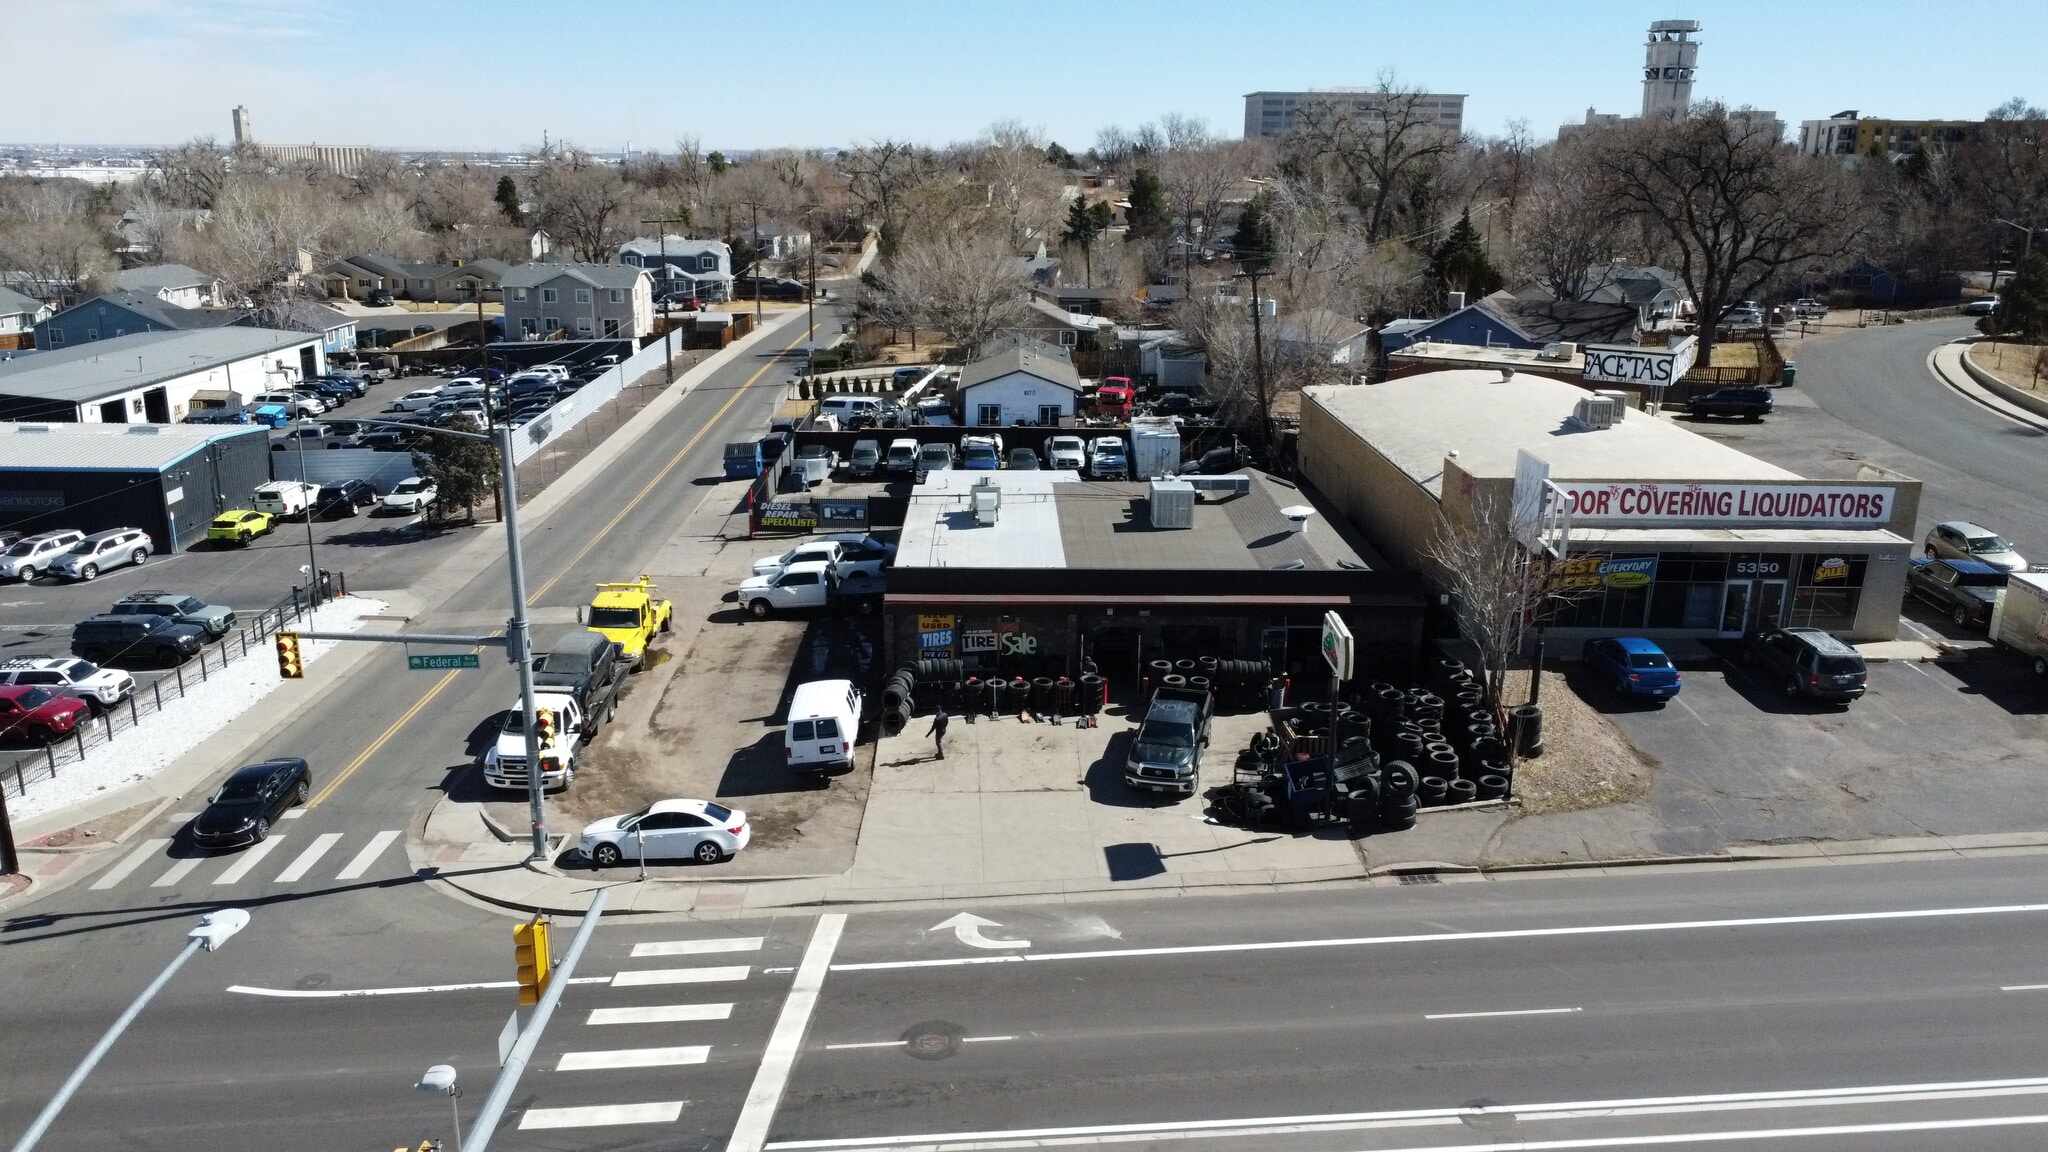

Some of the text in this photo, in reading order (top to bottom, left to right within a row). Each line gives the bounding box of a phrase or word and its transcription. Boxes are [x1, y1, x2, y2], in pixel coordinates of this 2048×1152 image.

[1582, 353, 1671, 381] FACETAS
[1546, 488, 1884, 518] OOR COVERING LIQUIDATORS
[765, 510, 799, 518] REPAIR
[761, 518, 817, 526] SPECIALISTS
[1599, 561, 1653, 573] EVERYDAY
[1737, 562, 1780, 573] 5350
[1815, 565, 1848, 582] SALE!
[922, 630, 953, 648] TIRES
[963, 636, 996, 648] TIRE
[1002, 632, 1037, 655] Sale
[423, 656, 461, 667] Federal
